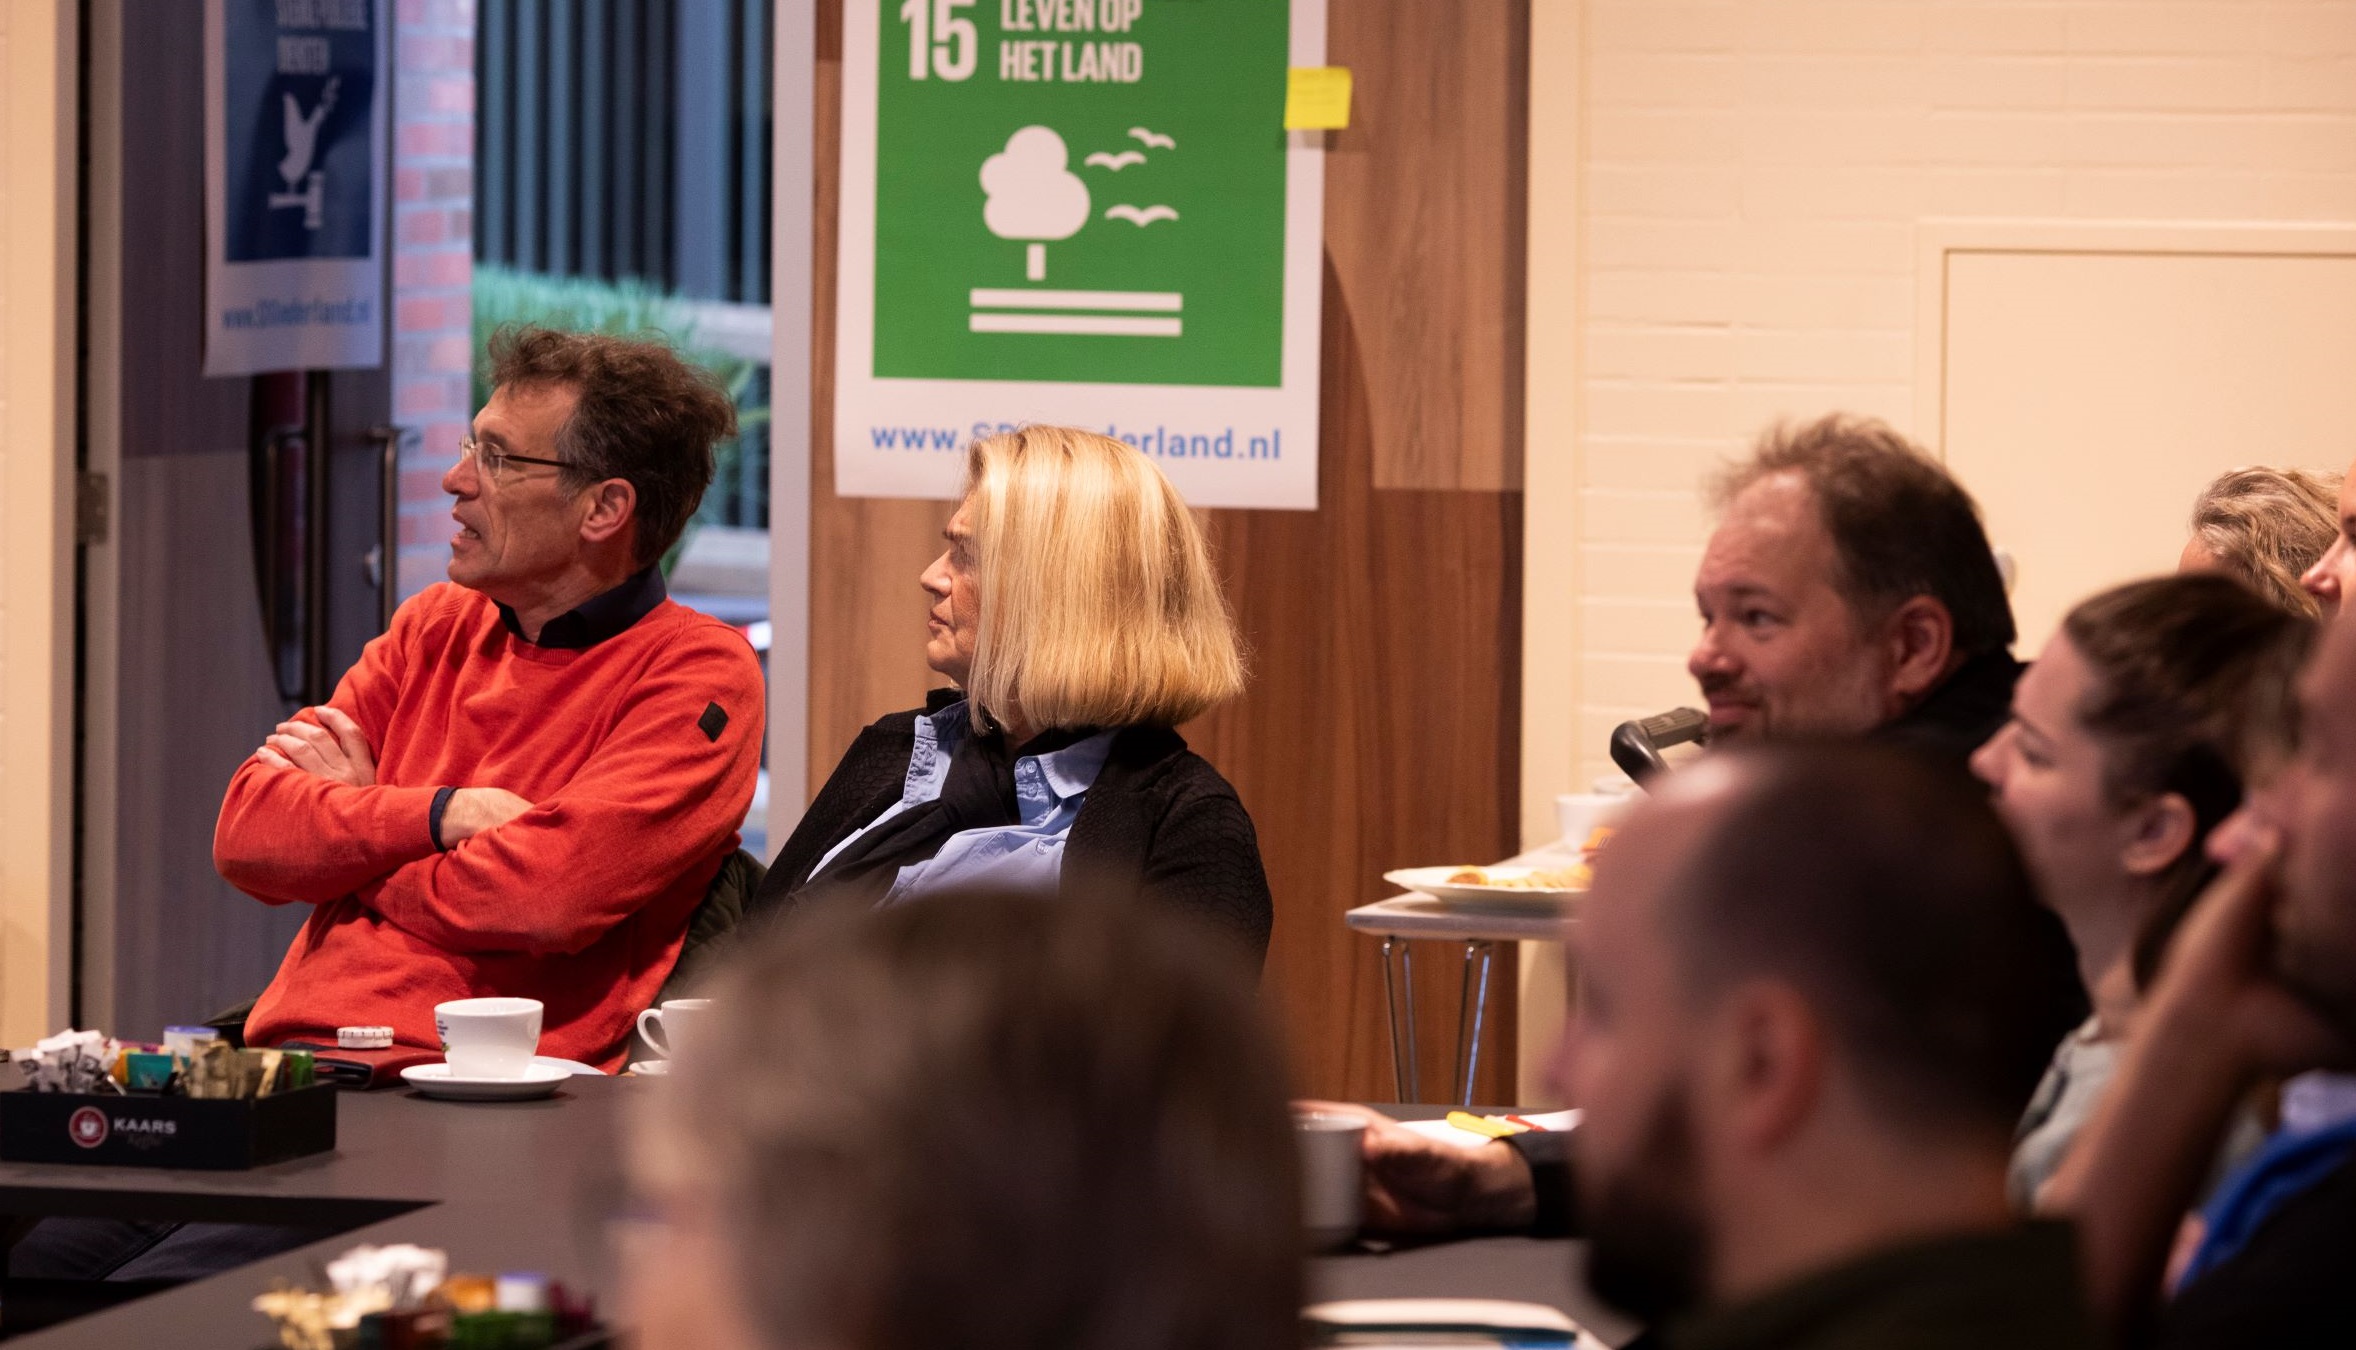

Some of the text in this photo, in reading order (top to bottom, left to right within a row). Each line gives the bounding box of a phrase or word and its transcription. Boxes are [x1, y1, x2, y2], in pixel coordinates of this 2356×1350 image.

[1000, 0, 1143, 32] LEVEN OP
[900, 0, 978, 81] 15
[999, 40, 1144, 83] HET LAND
[113, 1118, 177, 1134] KAARS
